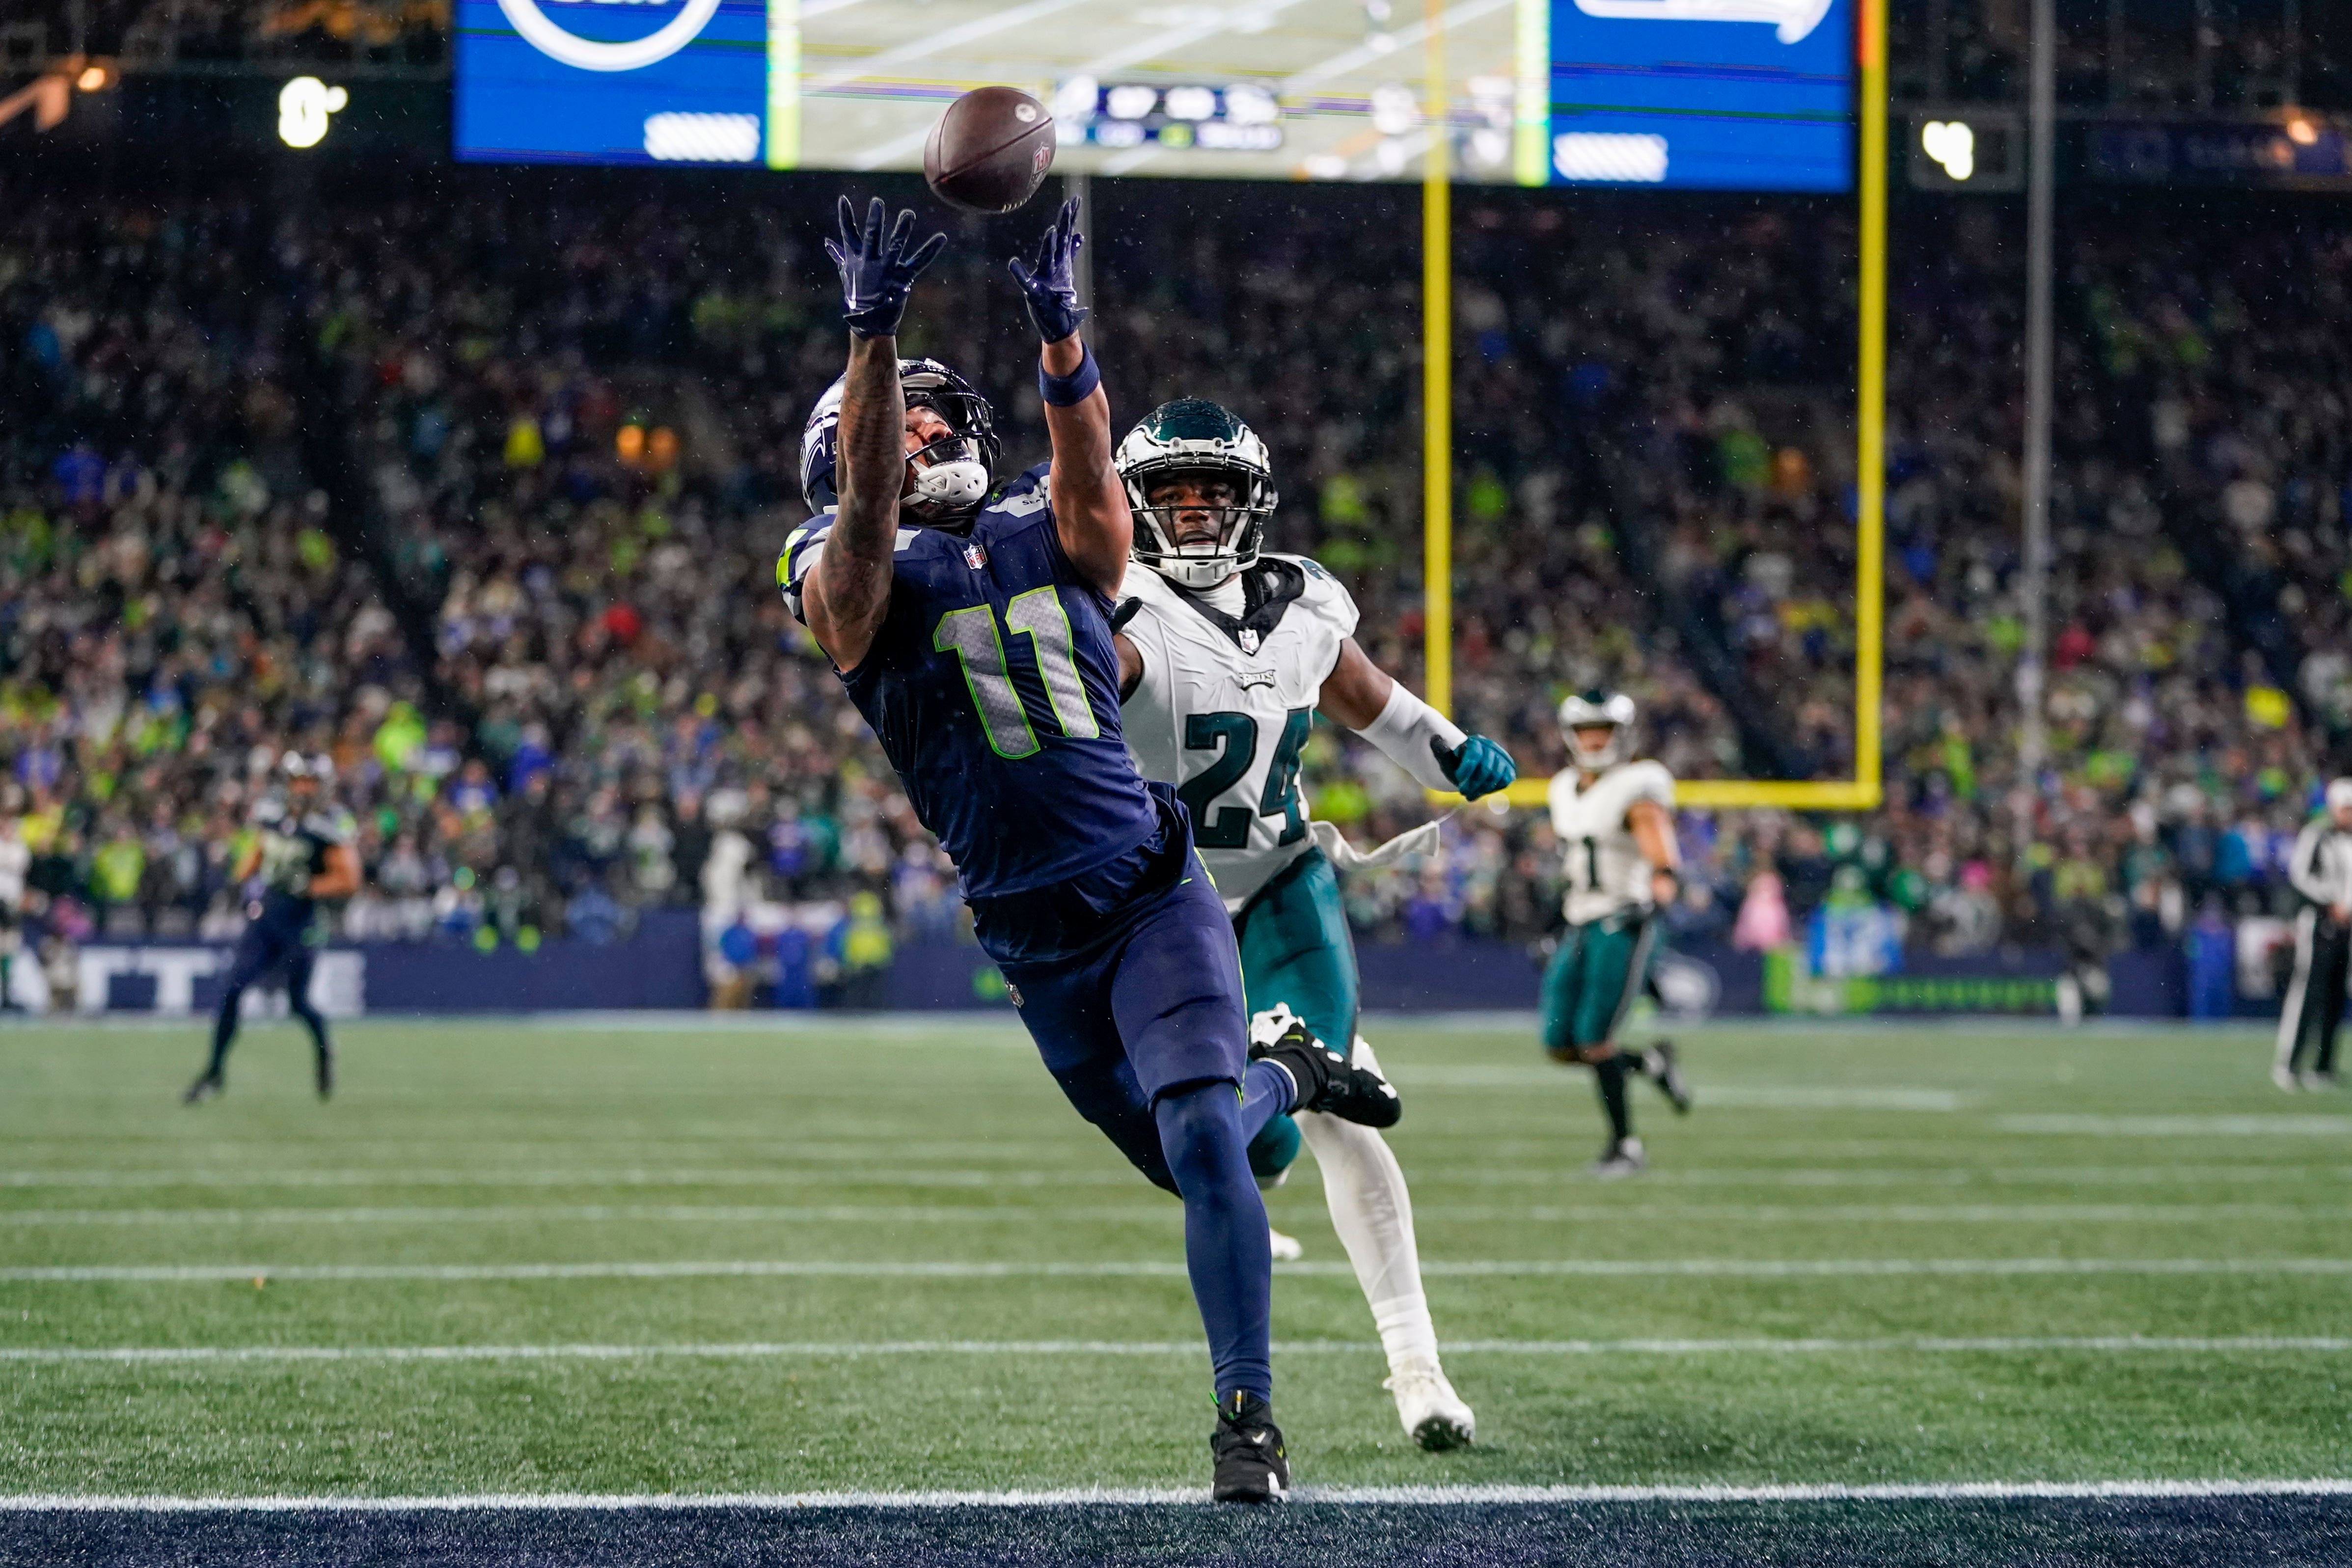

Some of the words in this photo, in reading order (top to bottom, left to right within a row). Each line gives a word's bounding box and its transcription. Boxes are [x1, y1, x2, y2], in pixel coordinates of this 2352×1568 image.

[1035, 149, 1050, 172] NFL
[969, 553, 985, 566] NFL
[932, 584, 1100, 760] 11
[1176, 706, 1310, 849] 24
